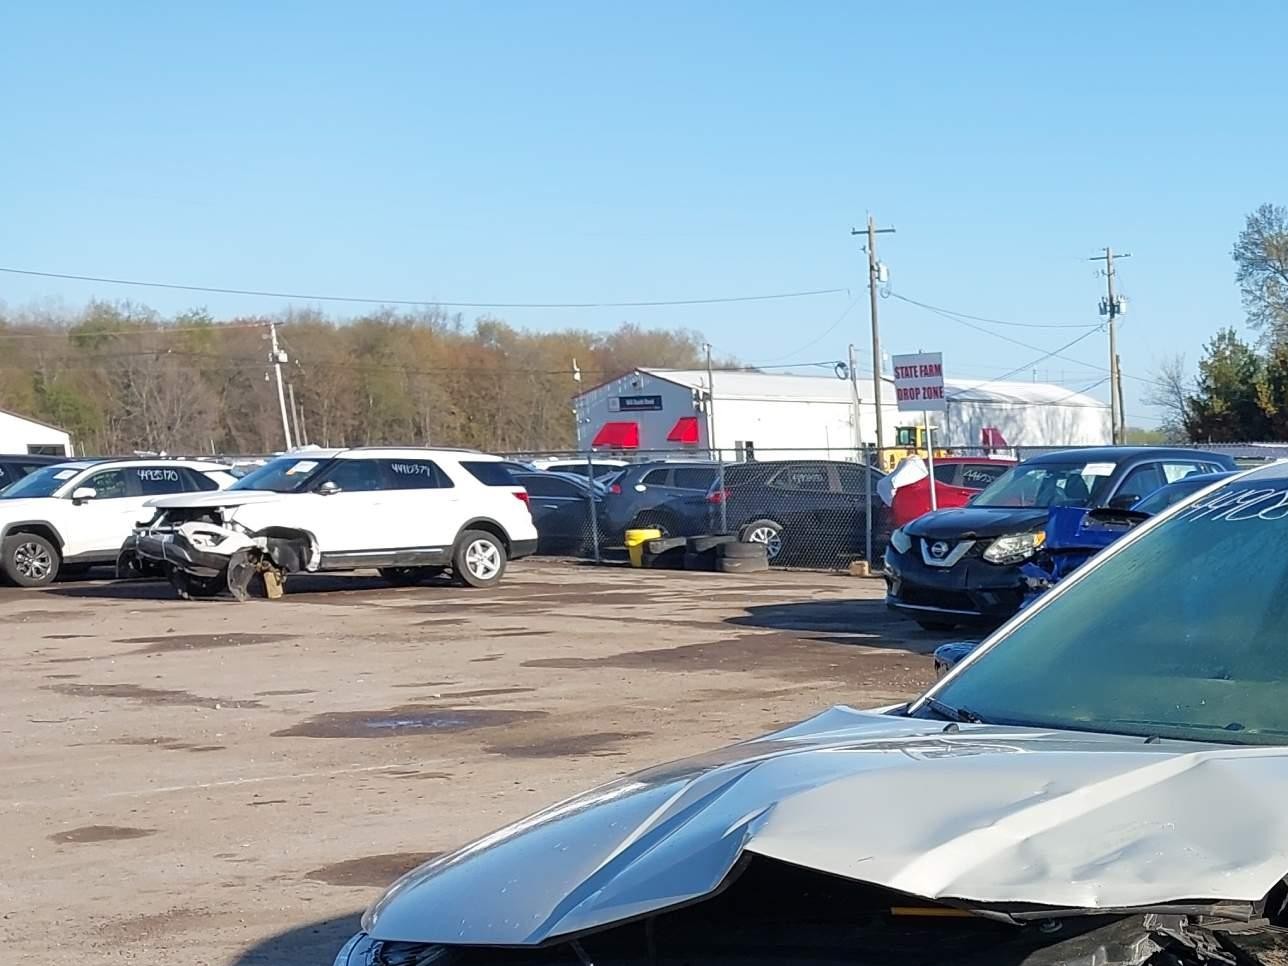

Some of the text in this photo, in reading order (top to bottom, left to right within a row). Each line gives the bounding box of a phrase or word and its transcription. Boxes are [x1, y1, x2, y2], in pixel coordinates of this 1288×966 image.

[895, 364, 942, 379] STATE FARM
[897, 386, 944, 401] DROP ZONE
